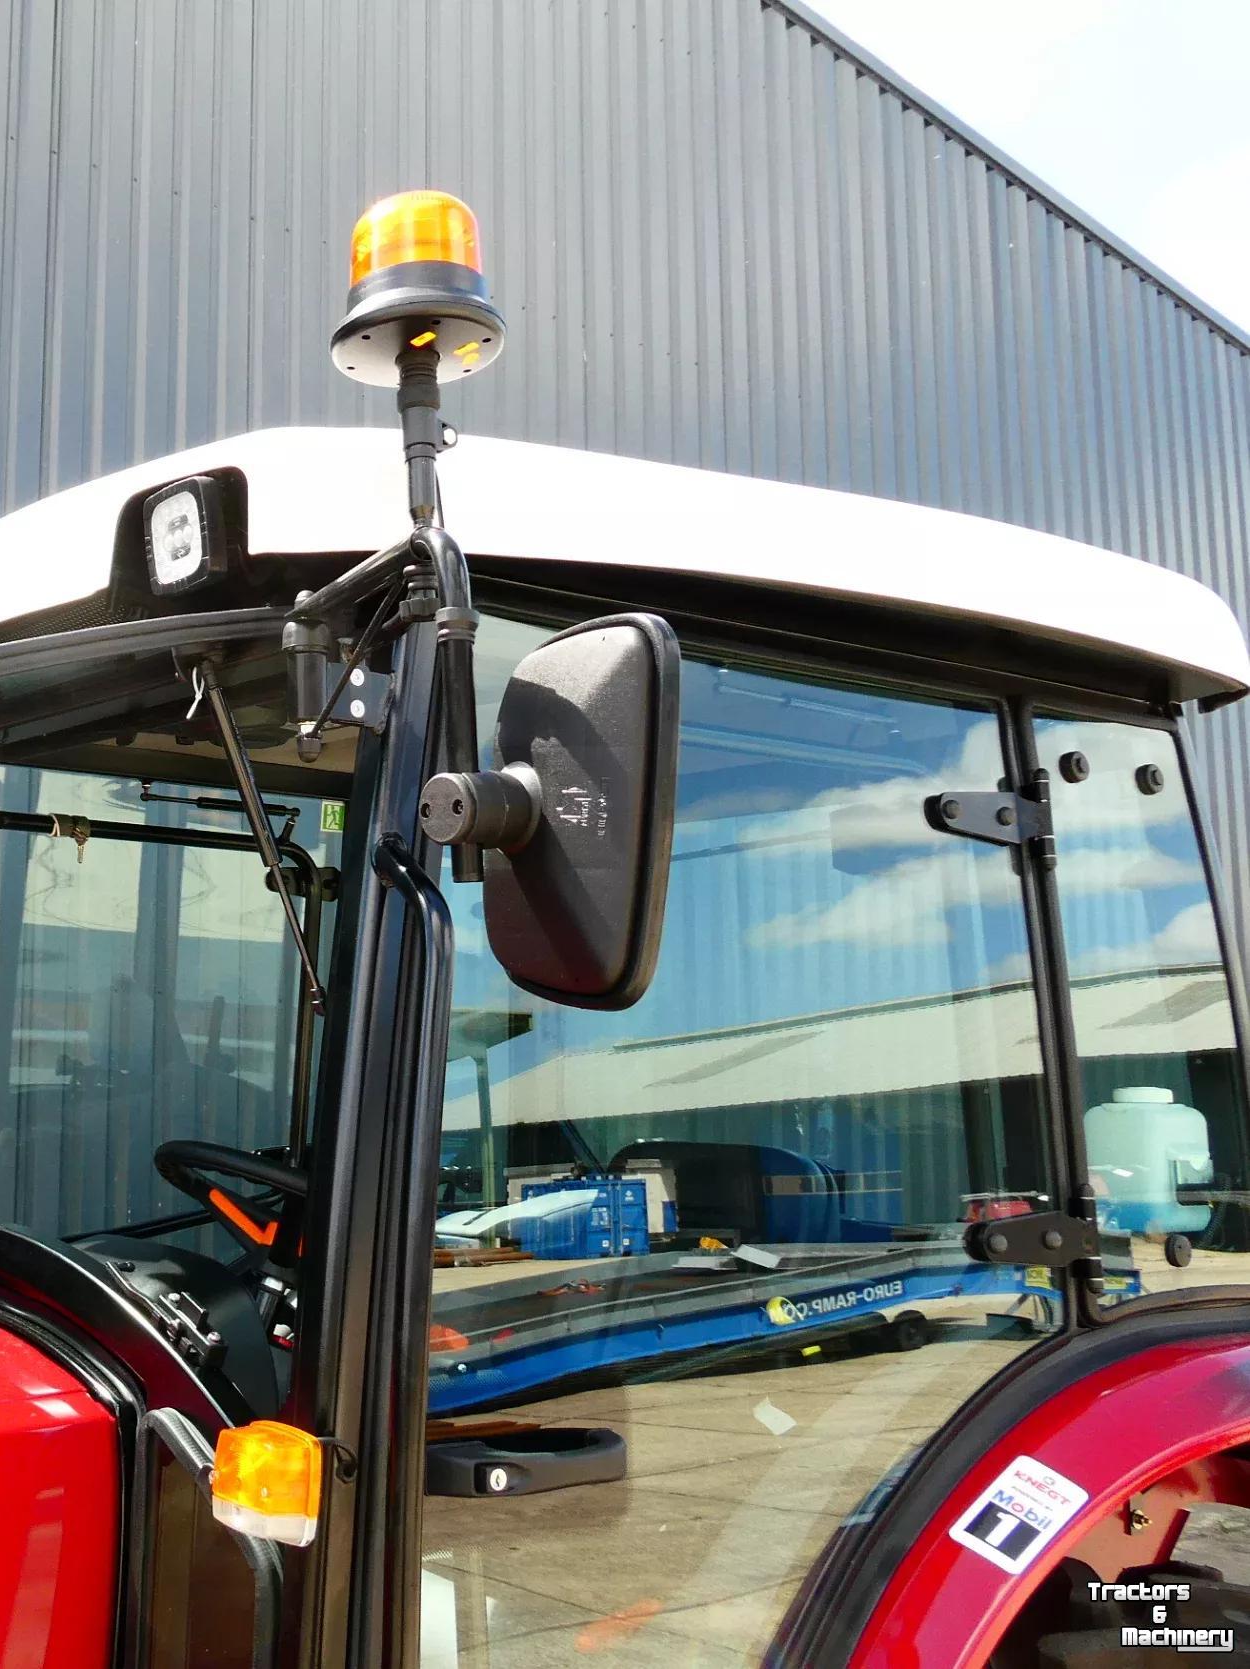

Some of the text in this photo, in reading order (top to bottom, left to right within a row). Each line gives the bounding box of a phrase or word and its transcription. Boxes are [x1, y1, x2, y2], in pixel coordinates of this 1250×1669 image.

[1014, 1470, 1070, 1505] KNEGT
[992, 1489, 1052, 1529] Mobil
[985, 1511, 1021, 1548] 1
